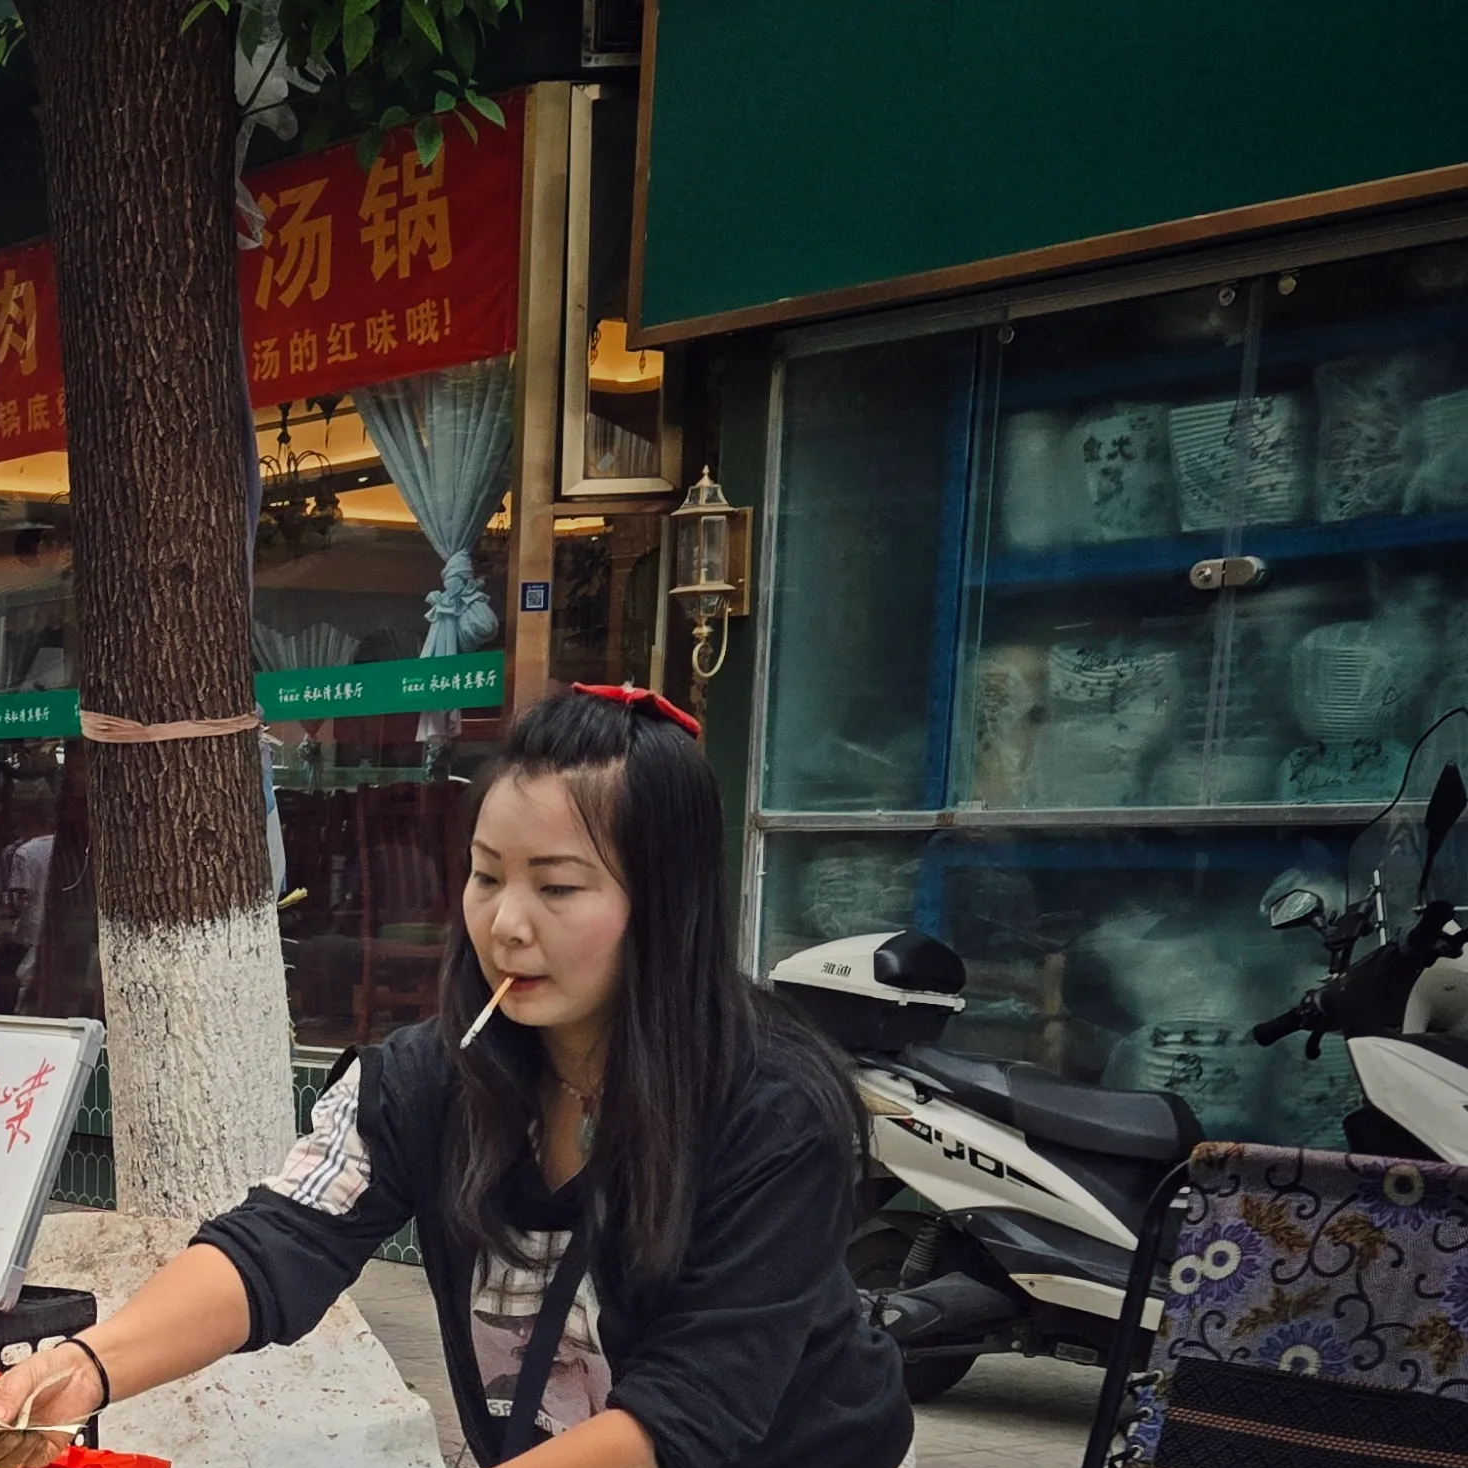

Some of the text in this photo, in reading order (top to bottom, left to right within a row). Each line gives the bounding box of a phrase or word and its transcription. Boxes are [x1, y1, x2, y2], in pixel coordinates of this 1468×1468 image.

[255, 147, 452, 311] 汤锅
[303, 682, 364, 703] 永弘清真餐厅
[429, 669, 496, 691] 永弘清真餐厅
